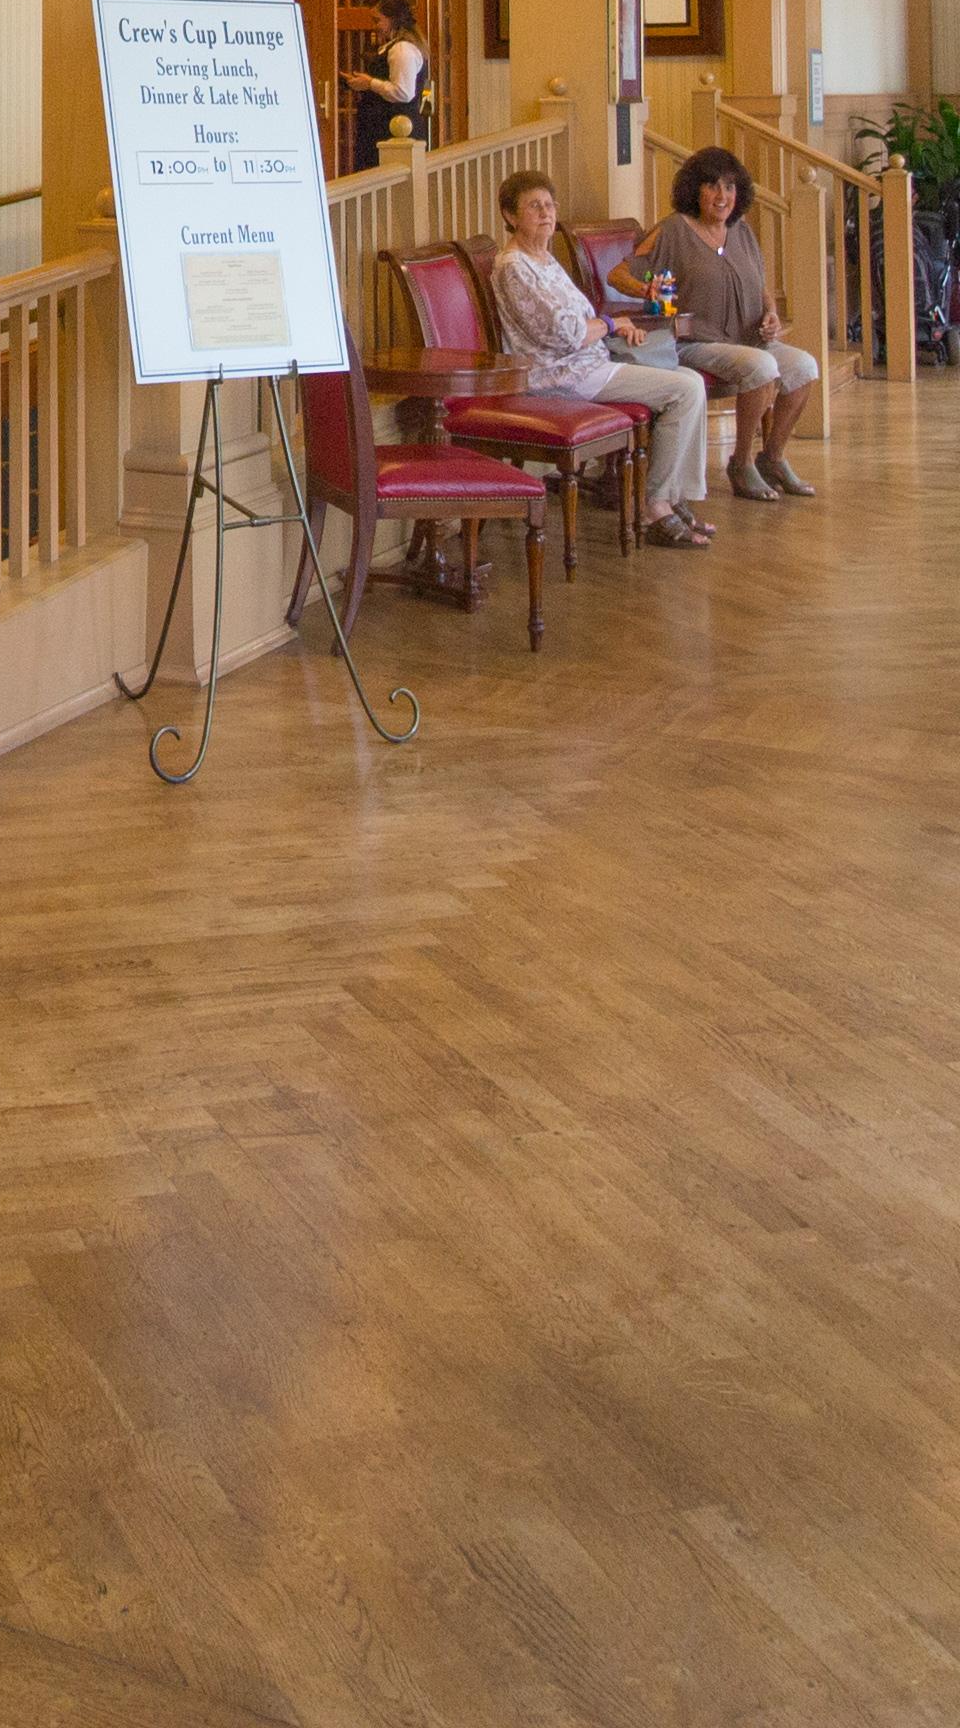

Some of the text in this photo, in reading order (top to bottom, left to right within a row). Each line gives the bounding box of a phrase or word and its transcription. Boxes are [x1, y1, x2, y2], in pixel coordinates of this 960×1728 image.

[118, 17, 285, 51] Crew's Cup Lounge
[155, 57, 259, 80] Serving Lunch,
[140, 85, 280, 109] Dinner & Late Night
[193, 124, 240, 144] Hours:
[213, 156, 227, 173] to
[180, 224, 276, 246] Current Menu
